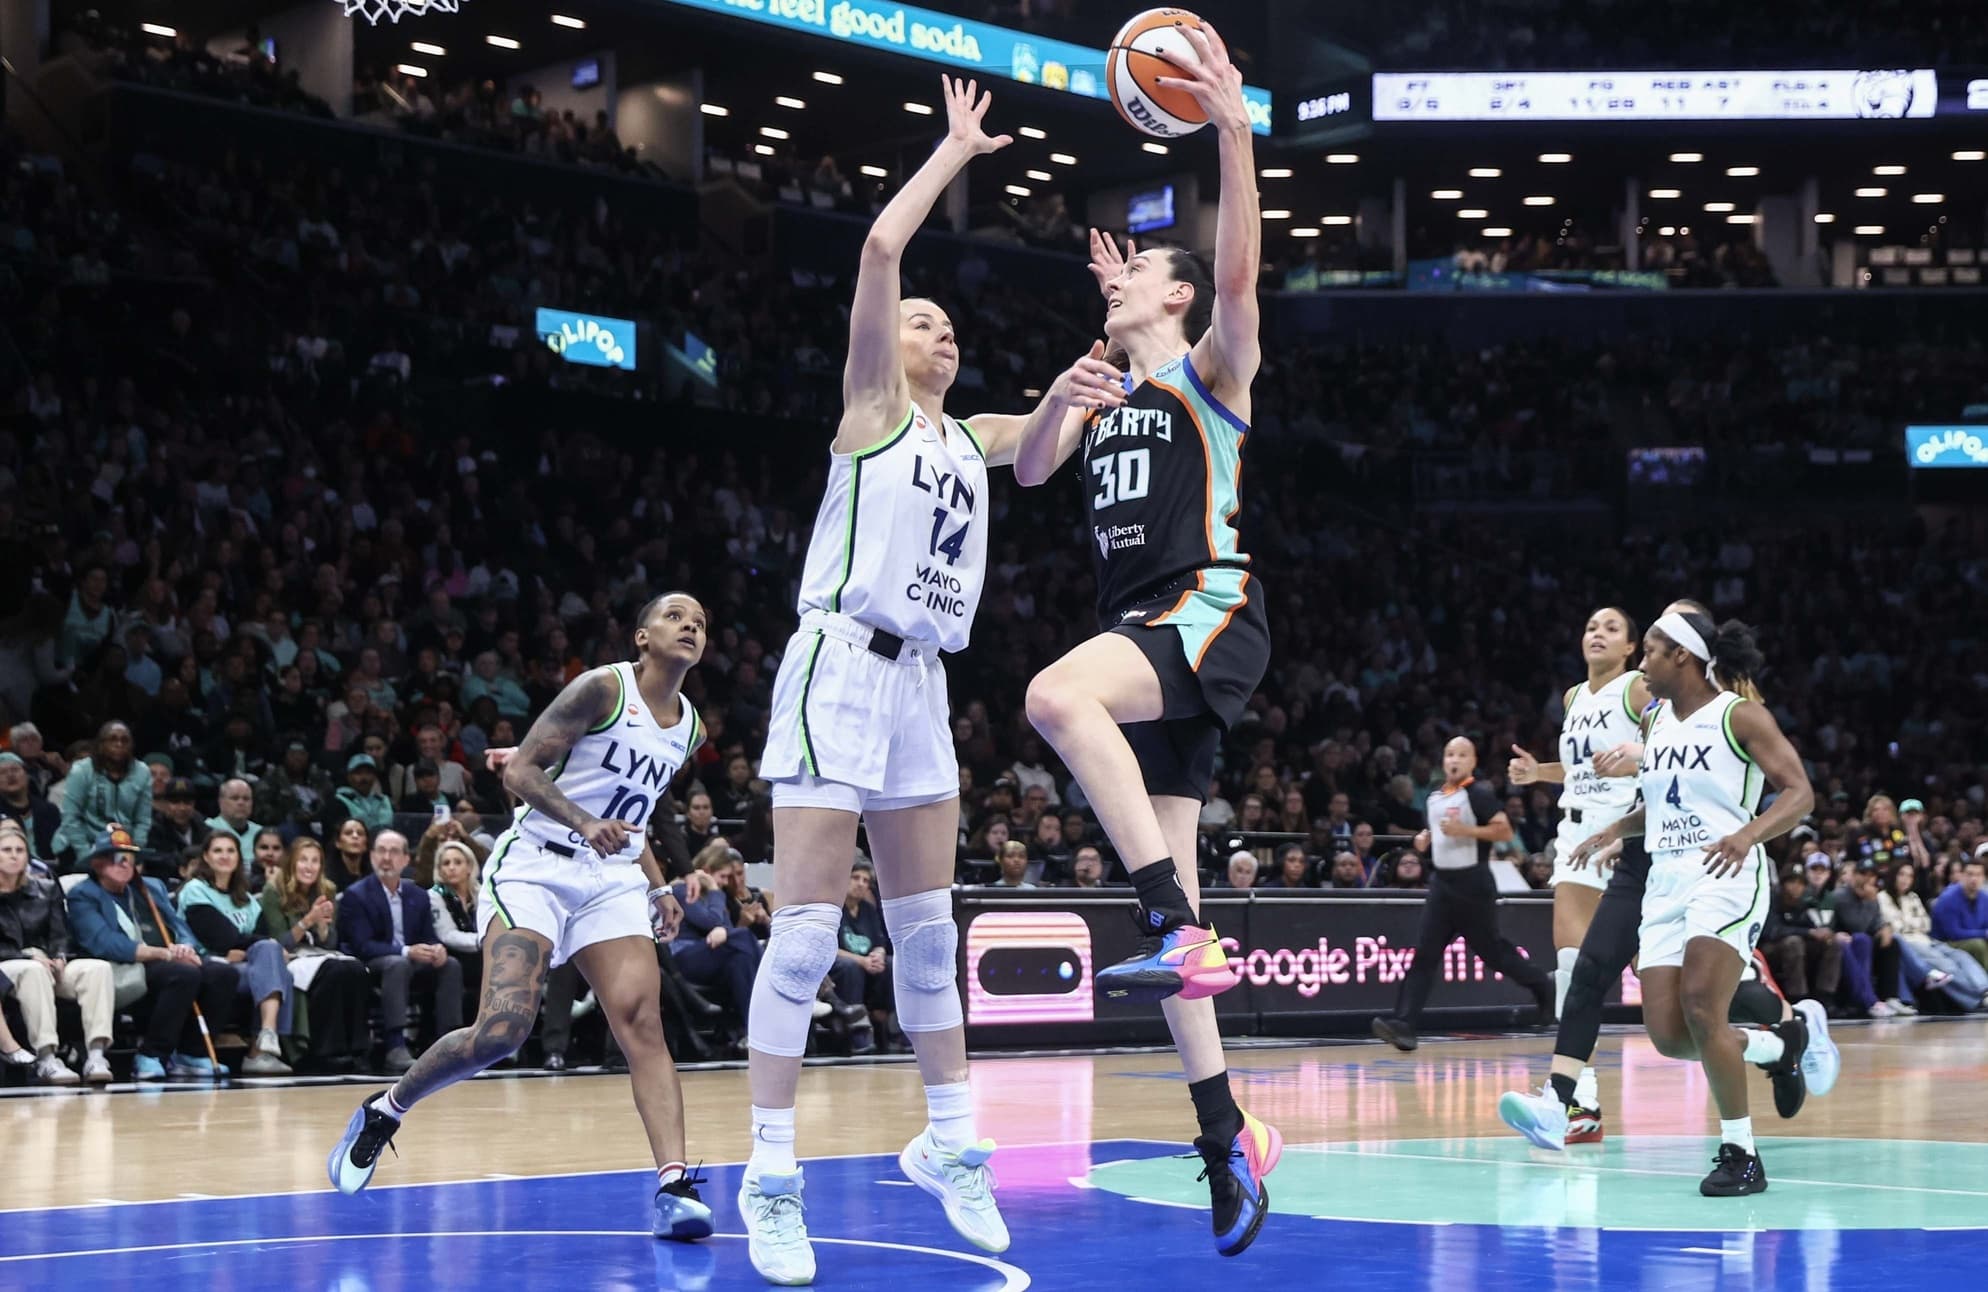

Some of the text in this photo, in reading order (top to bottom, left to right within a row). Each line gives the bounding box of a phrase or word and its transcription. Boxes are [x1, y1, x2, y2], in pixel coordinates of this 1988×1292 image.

[829, 1, 905, 44] good
[910, 22, 983, 61] soda
[912, 454, 977, 516] LYN
[1091, 448, 1150, 511] 30
[930, 506, 970, 567] 14
[1108, 523, 1145, 540] Liberty
[916, 561, 962, 594] MAYO
[906, 583, 965, 618] CINIC
[1561, 709, 1612, 735] YNX
[1567, 735, 1594, 766] 24
[601, 785, 649, 826] 10
[1574, 782, 1612, 795] CLINIC
[1666, 773, 1682, 809] 4
[1658, 829, 1709, 849] CLINIC
[1662, 815, 1702, 833] MAYO
[1219, 936, 1350, 997] Google
